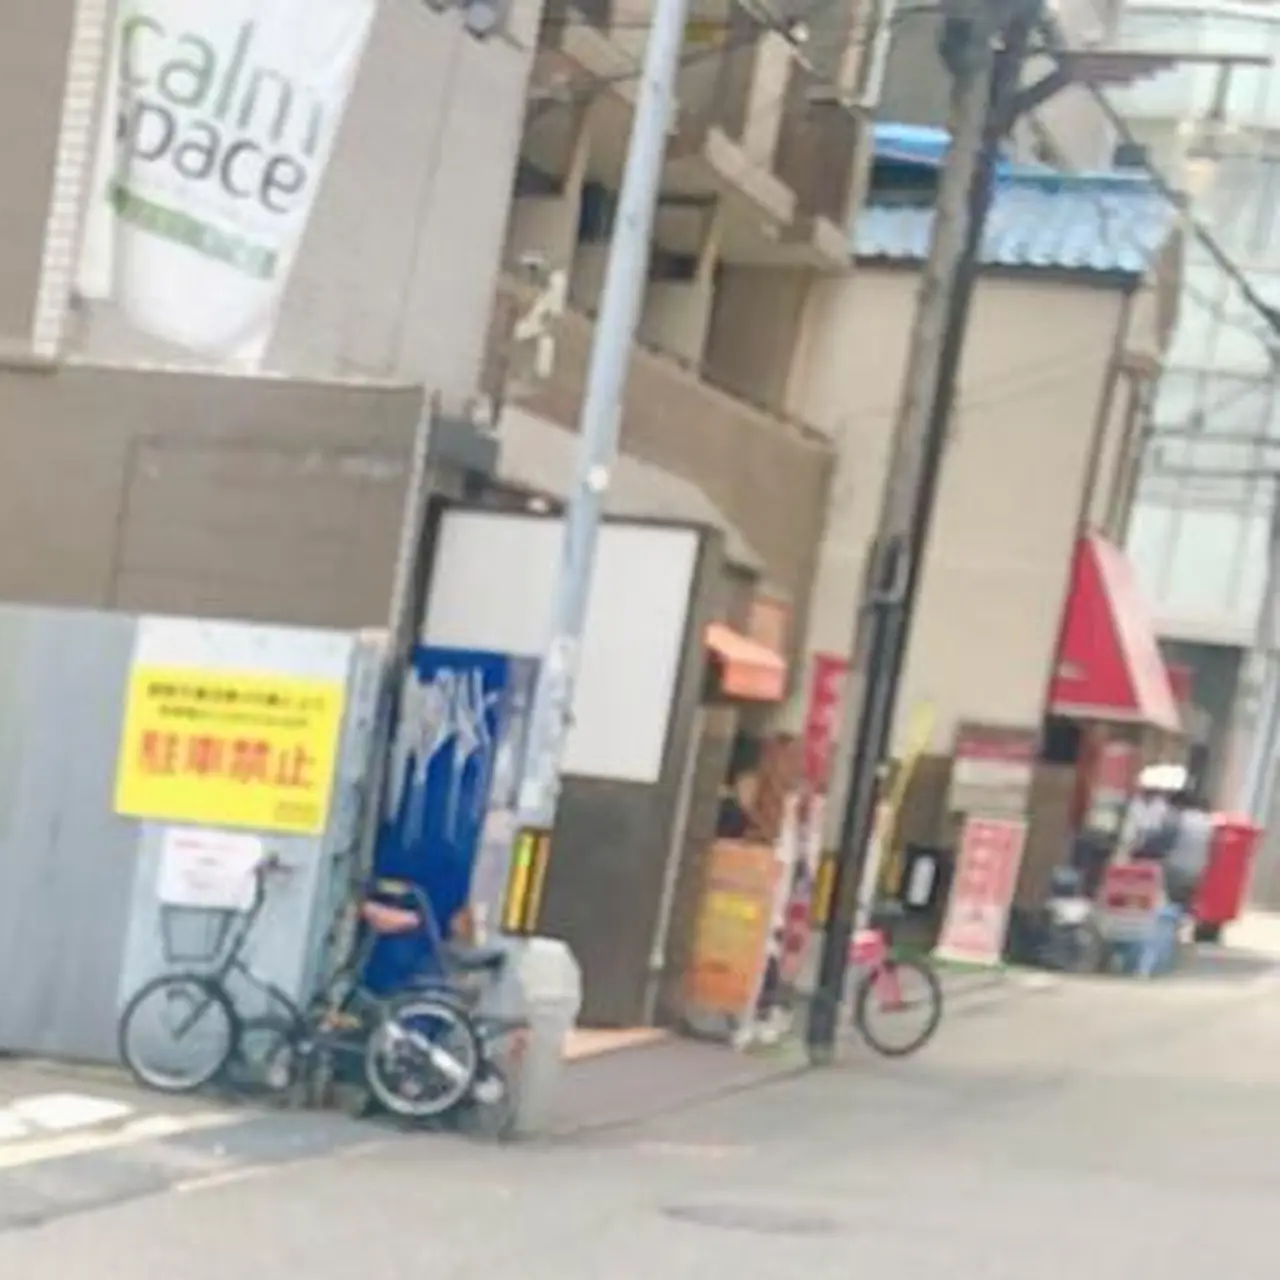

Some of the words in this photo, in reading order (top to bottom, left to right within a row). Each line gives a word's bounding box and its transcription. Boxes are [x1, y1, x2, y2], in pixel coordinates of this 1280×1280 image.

[117, 99, 307, 215] pace
[139, 729, 317, 788] 駐車禁止
